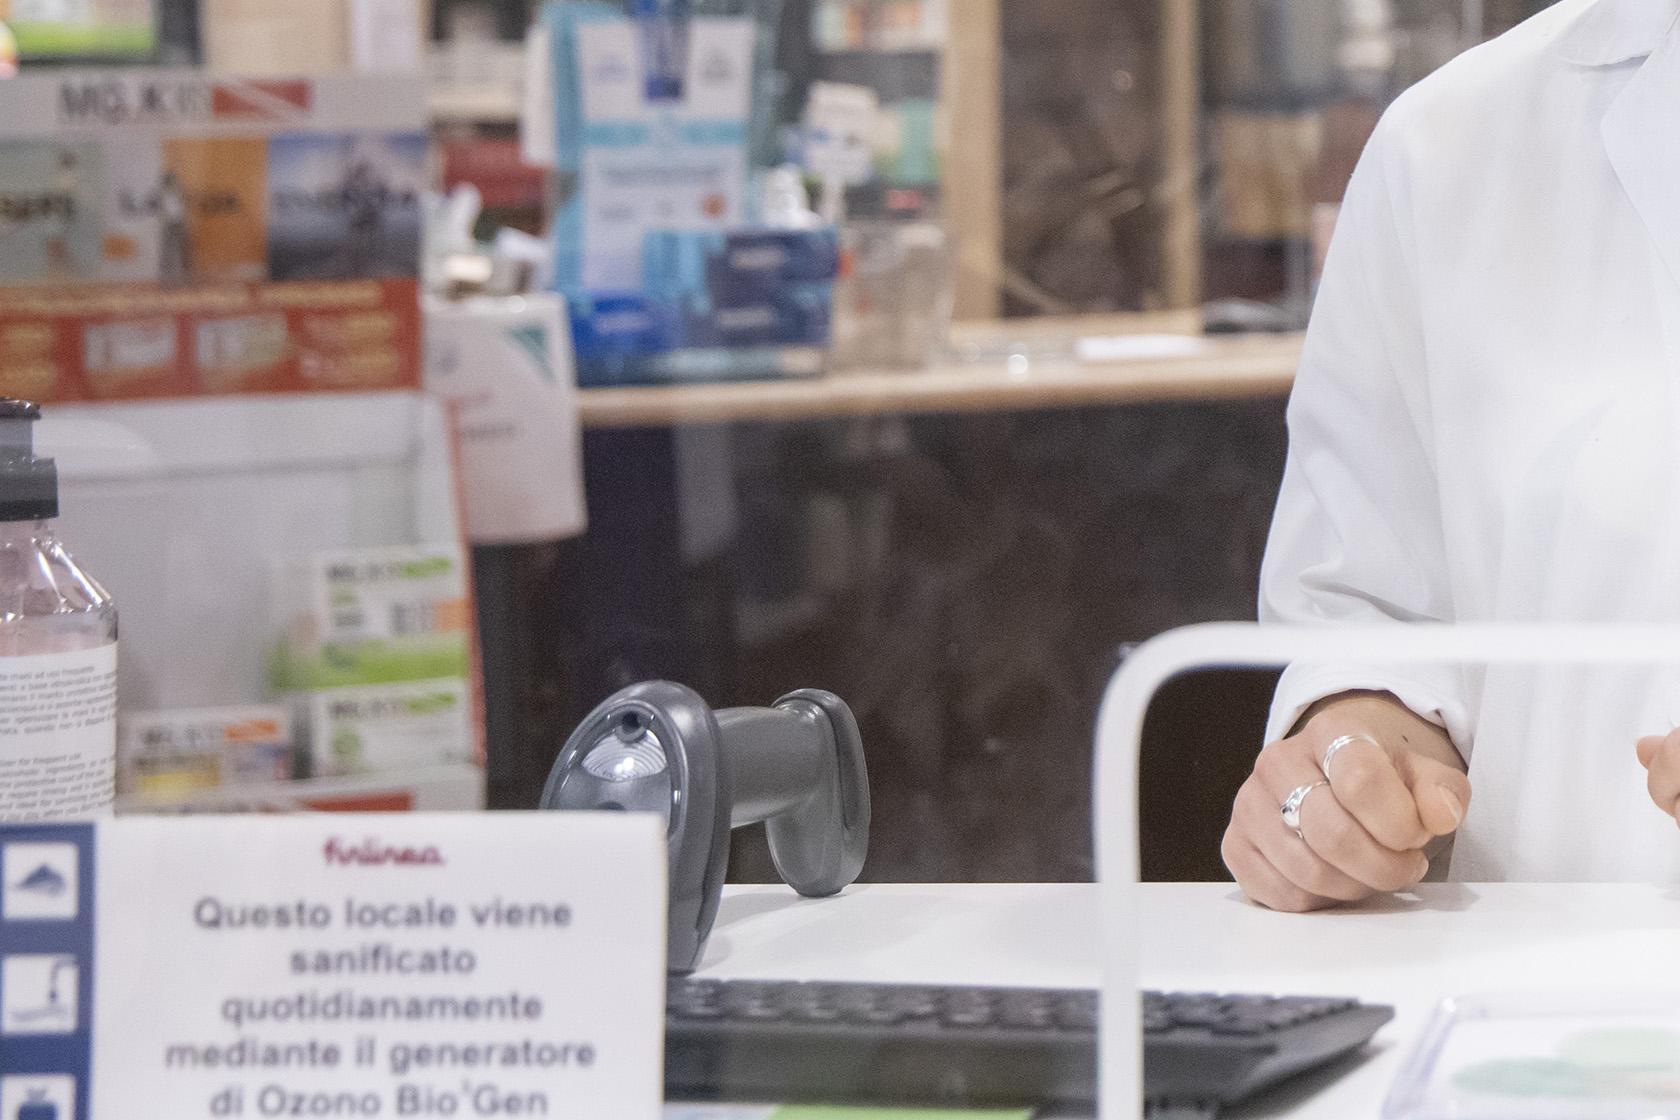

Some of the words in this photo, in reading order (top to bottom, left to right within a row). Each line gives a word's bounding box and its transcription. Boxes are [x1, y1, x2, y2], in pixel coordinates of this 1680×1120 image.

[192, 894, 333, 932] Questo
[344, 896, 457, 930] locale
[470, 897, 573, 929] viene
[289, 942, 478, 977] sanificato
[220, 990, 544, 1030] quotidianamente
[164, 1036, 342, 1070] mediante
[354, 1036, 378, 1068] il
[388, 1038, 598, 1077] generatore
[208, 1086, 245, 1118] di
[256, 1084, 383, 1119] Ozono
